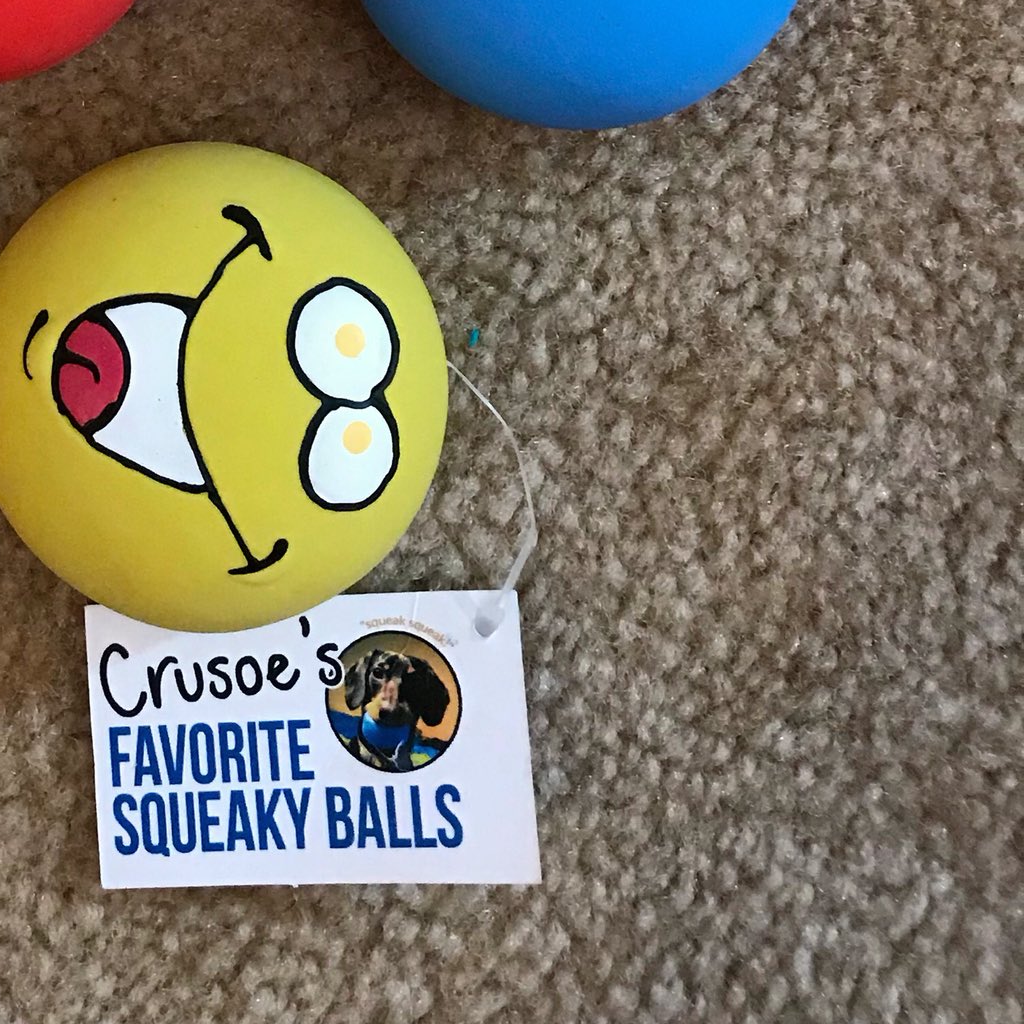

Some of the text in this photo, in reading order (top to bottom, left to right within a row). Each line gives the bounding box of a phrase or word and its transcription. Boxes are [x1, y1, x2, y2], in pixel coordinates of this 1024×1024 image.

[100, 616, 343, 717] Crusoe's
[108, 720, 315, 787] FAVORITE
[112, 783, 463, 857] SQUEAKY BALLS
